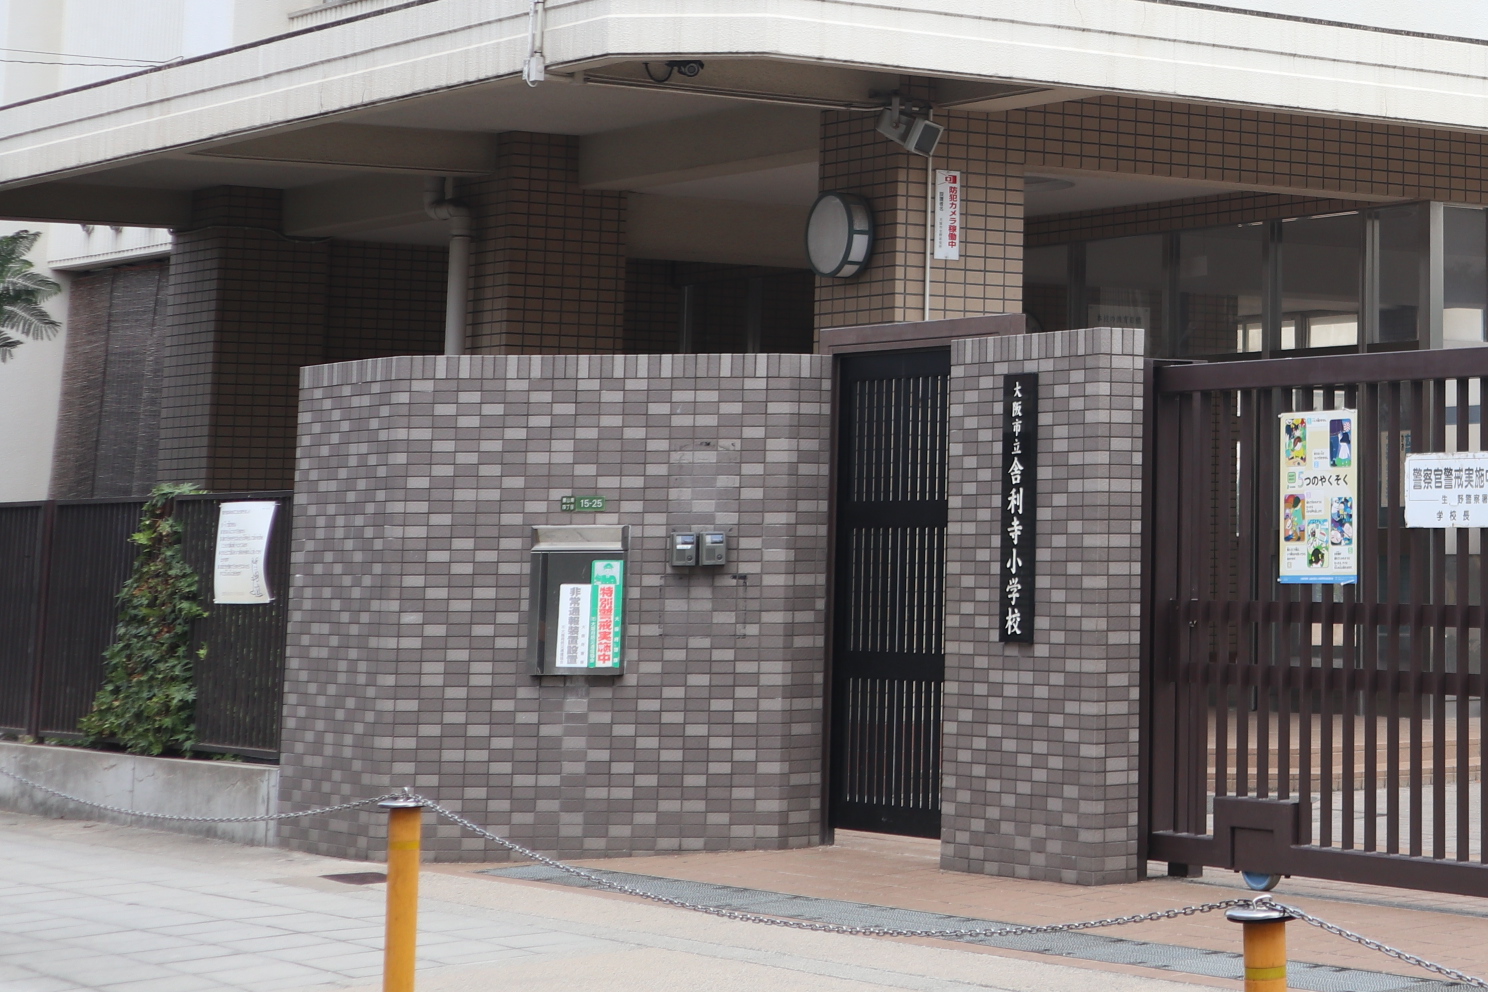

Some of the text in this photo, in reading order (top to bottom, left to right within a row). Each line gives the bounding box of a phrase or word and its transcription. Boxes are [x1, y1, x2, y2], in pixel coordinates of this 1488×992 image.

[948, 186, 958, 248] 防犯カメラ稼働中
[1298, 471, 1348, 488] 5つのやくそく
[580, 499, 603, 508] 15-25
[1436, 510, 1470, 522] 学校長
[597, 586, 613, 664] 特別警戒実施中
